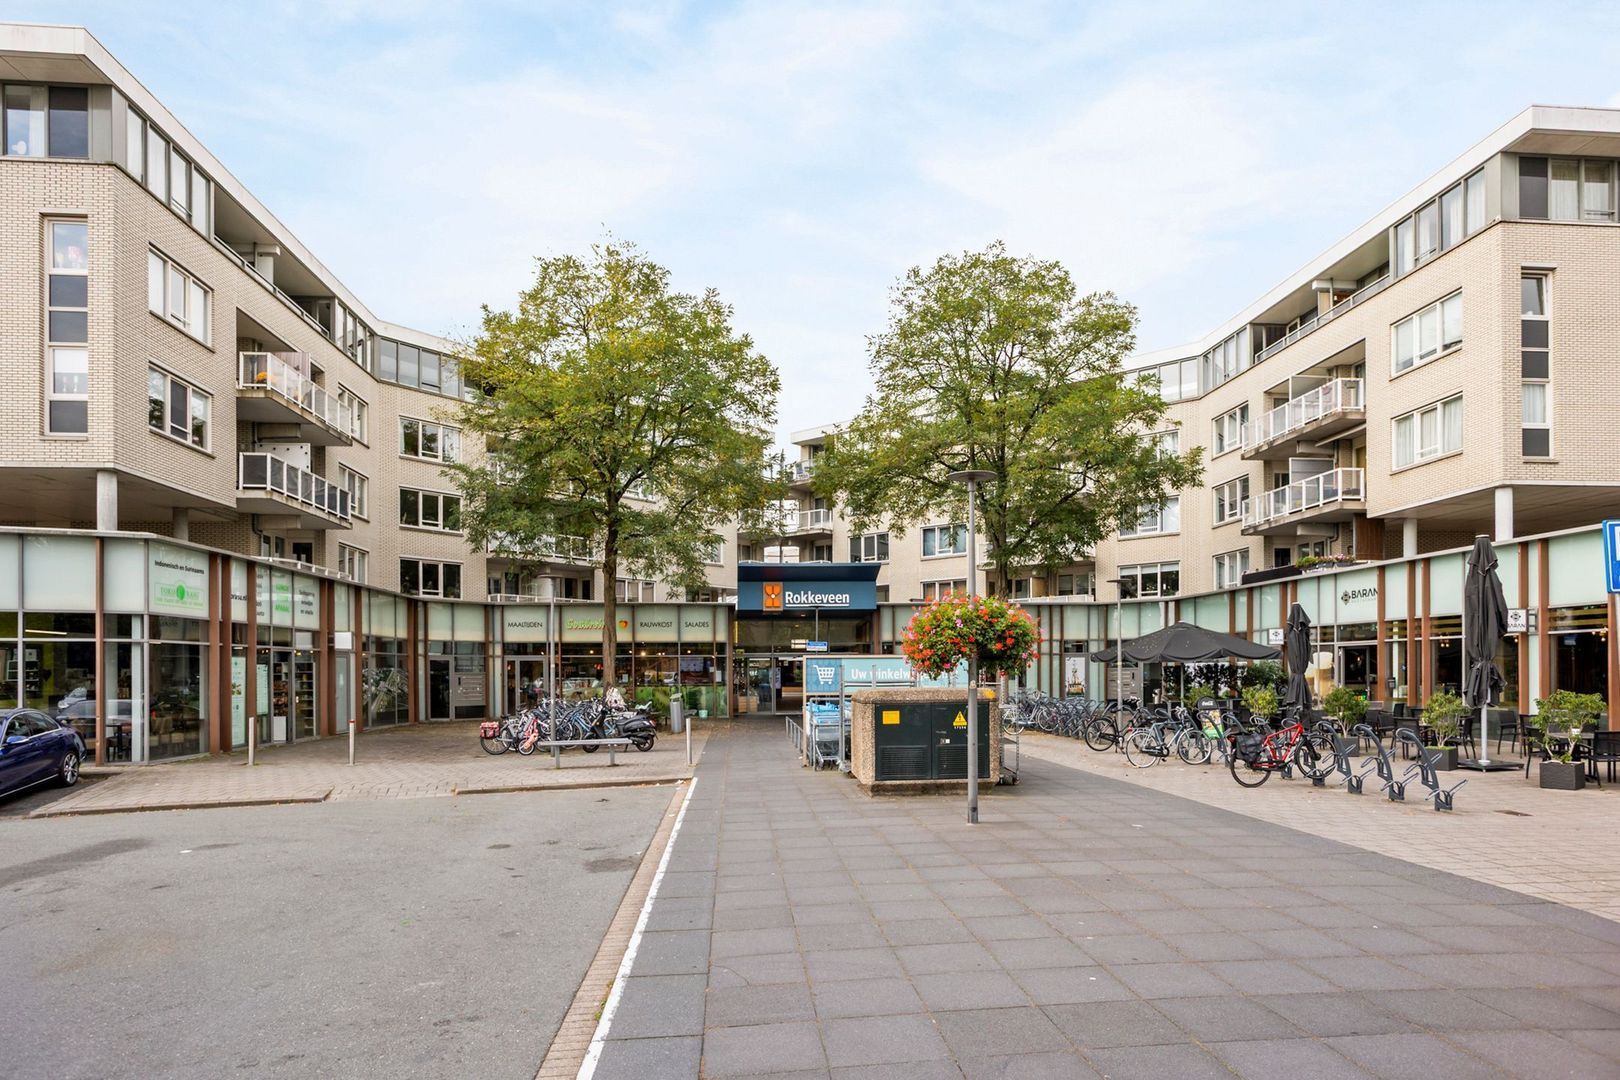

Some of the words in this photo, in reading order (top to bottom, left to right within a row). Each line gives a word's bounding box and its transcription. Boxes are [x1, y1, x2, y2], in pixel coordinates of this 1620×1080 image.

[154, 560, 179, 570] Indonesisch
[785, 591, 850, 604] Rokkeveen
[1351, 588, 1378, 599] BARAN
[507, 621, 543, 629] MAALTIJDEN
[640, 621, 673, 629] RAUWKOST
[851, 668, 867, 680] Uw
